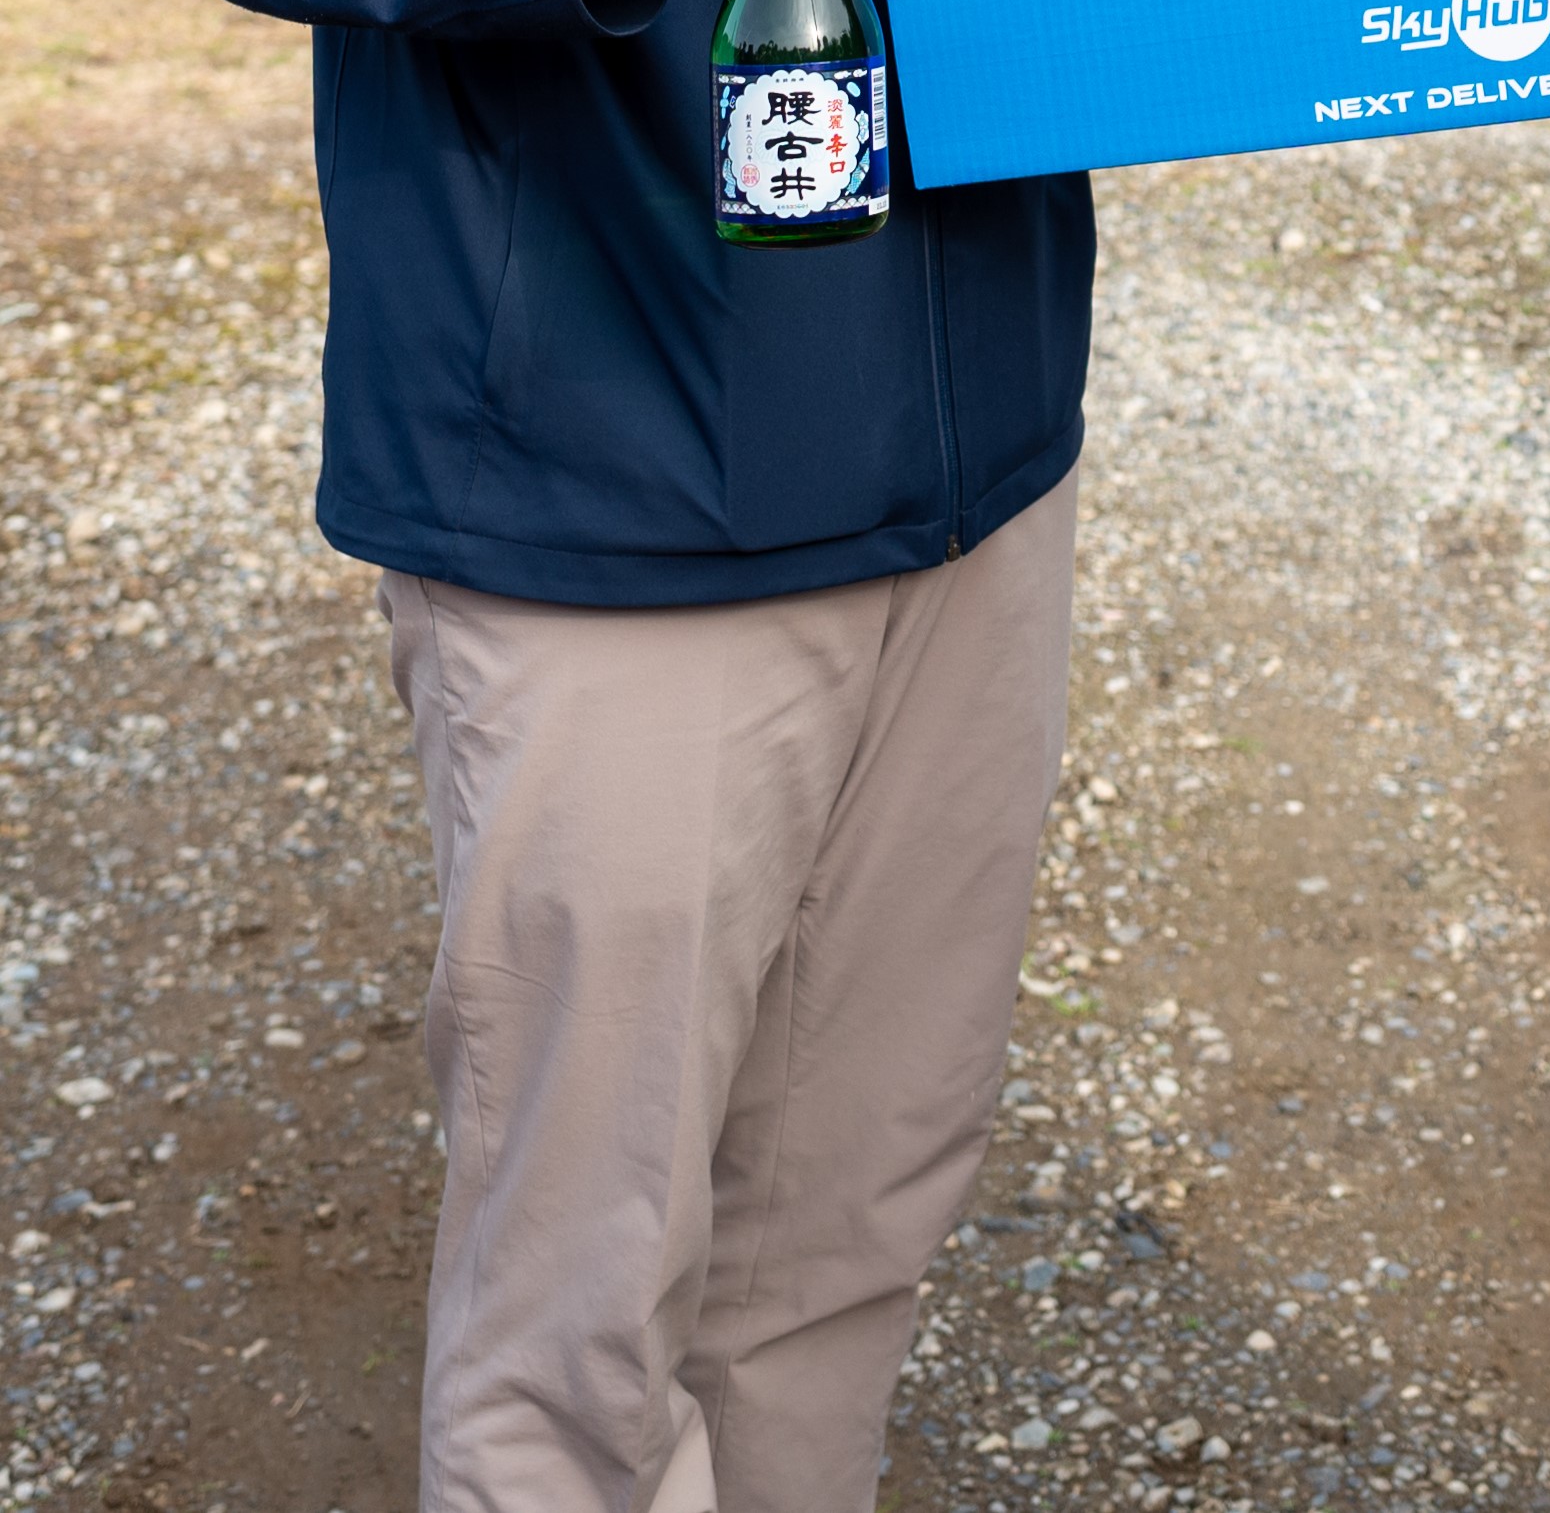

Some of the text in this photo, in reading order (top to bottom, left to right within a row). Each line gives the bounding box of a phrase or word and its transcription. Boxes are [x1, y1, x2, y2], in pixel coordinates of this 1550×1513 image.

[1314, 90, 1414, 123] NEXT
[761, 90, 825, 201] 腰古井
